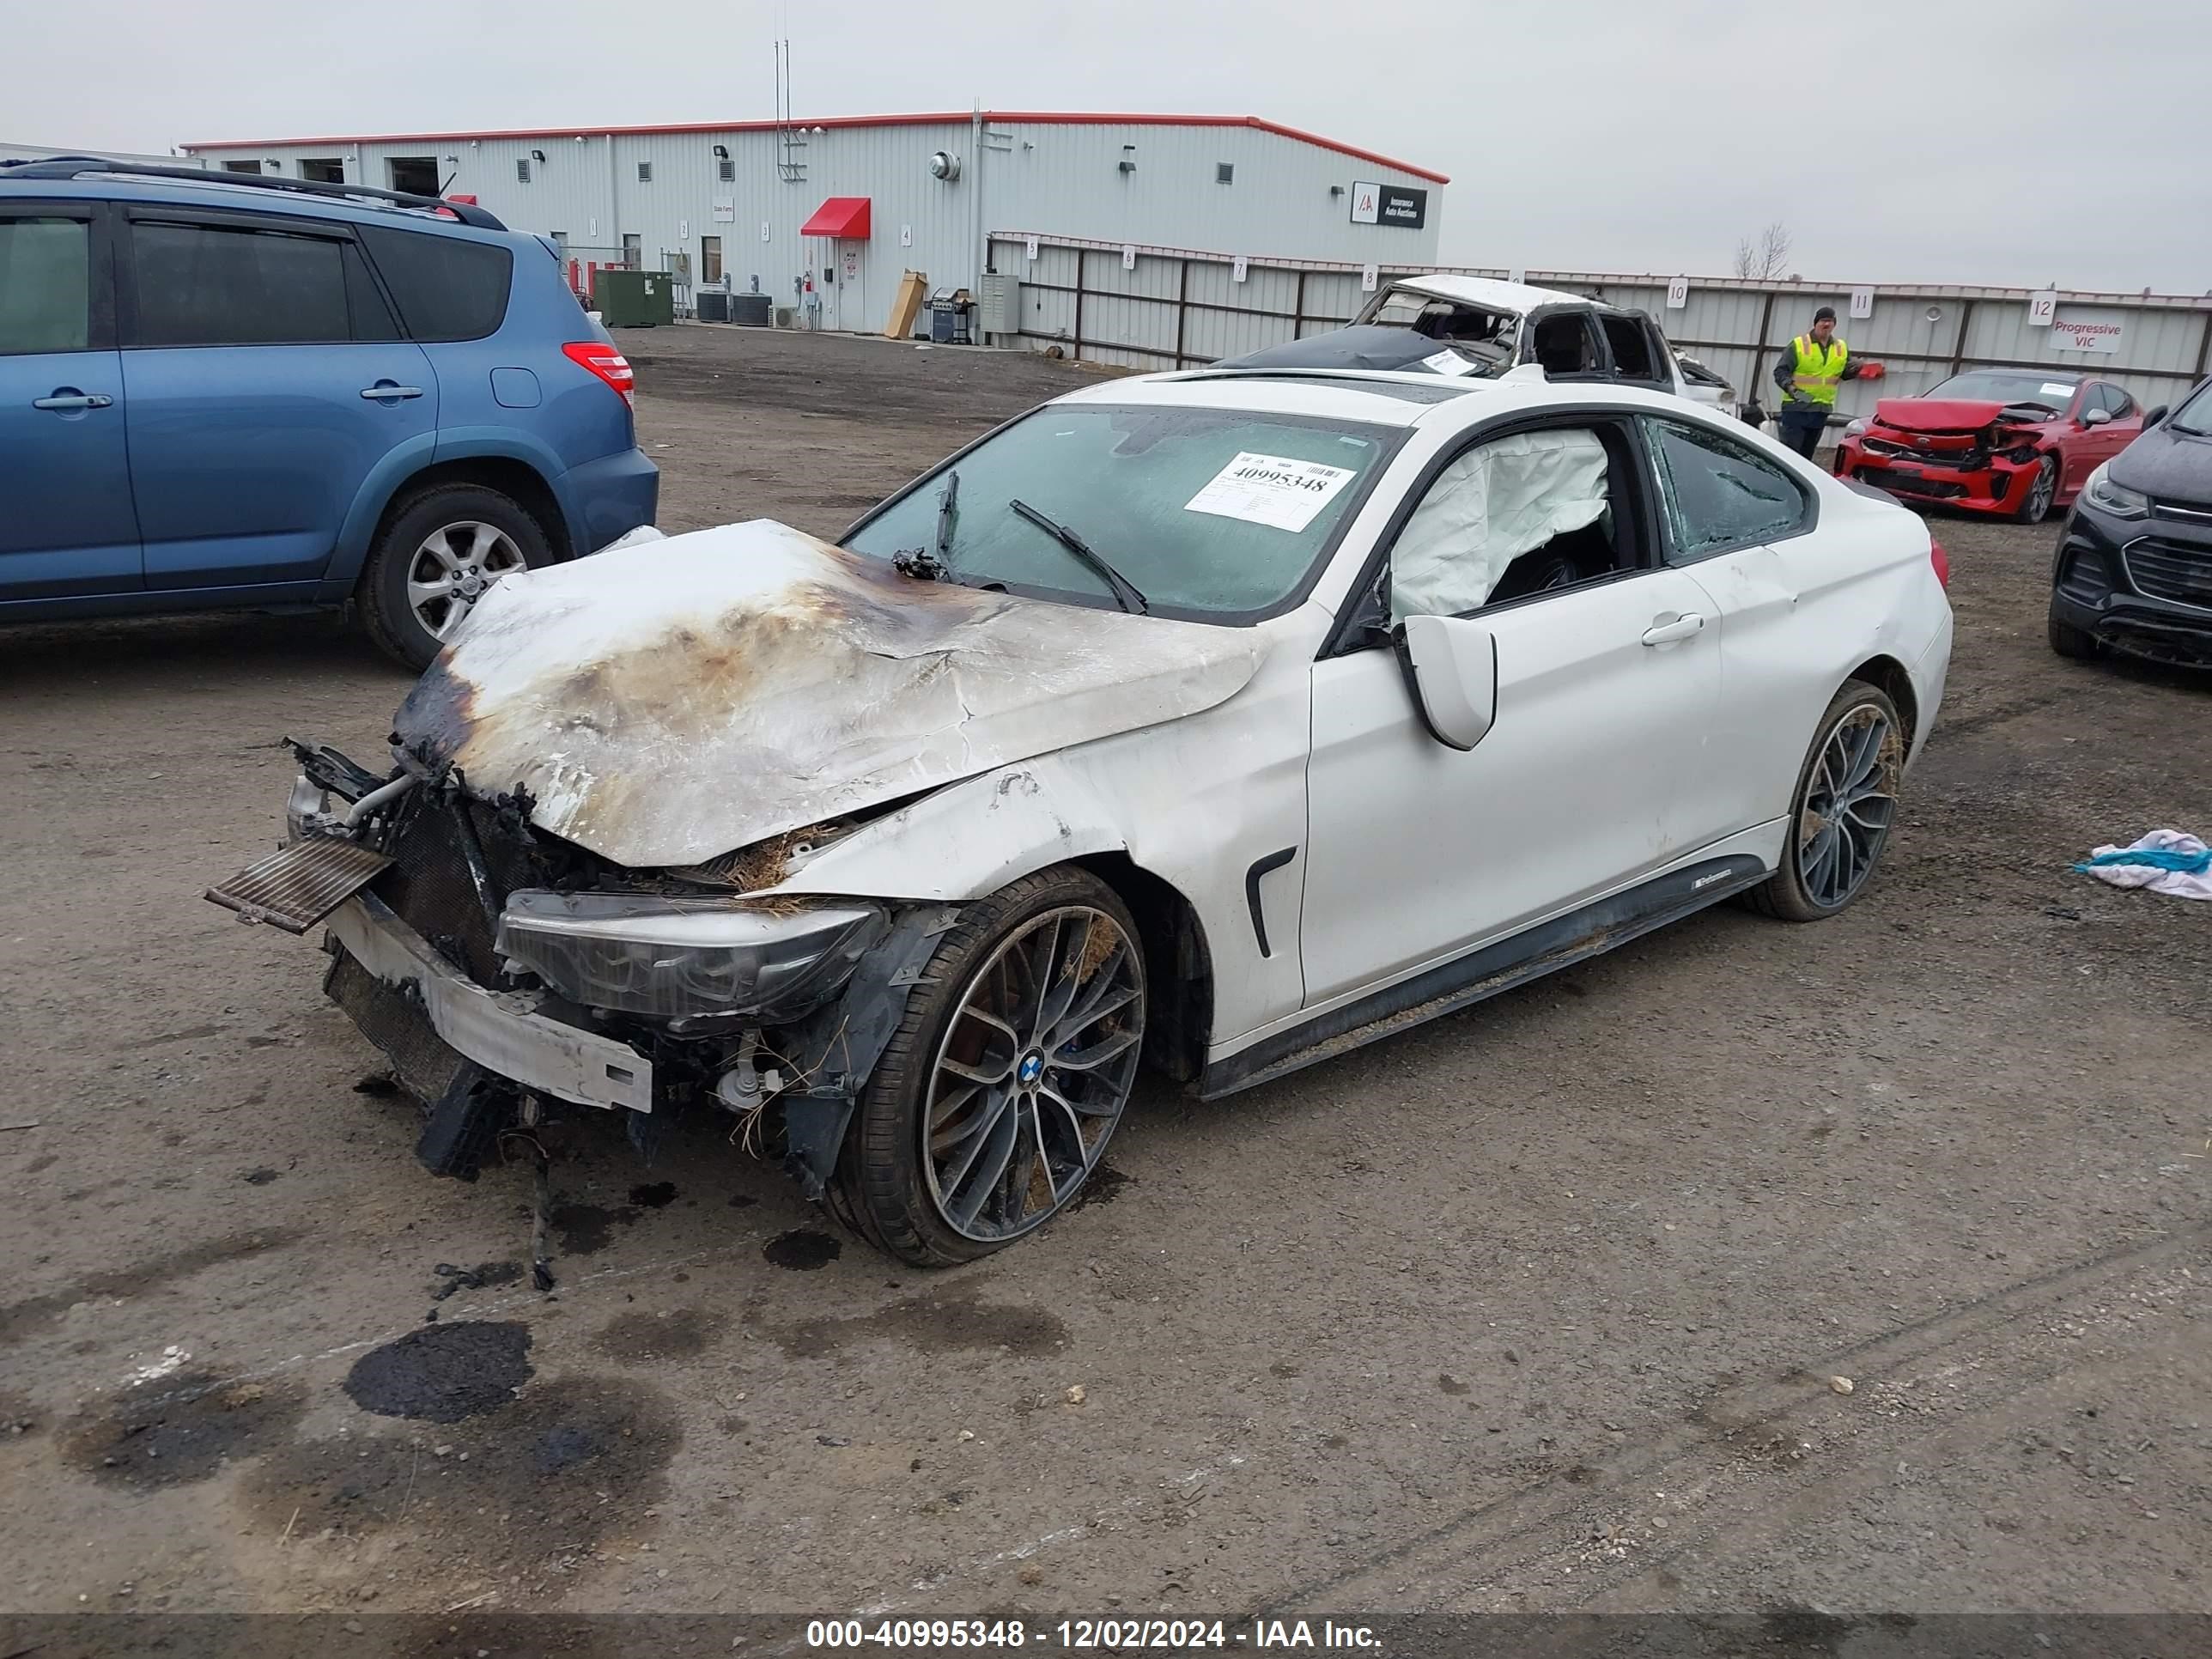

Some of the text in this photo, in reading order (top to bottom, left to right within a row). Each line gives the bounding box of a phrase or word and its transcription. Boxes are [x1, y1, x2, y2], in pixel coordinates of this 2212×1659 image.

[682, 224, 686, 234] 2
[903, 230, 908, 240] 4
[1030, 242, 1035, 252] 5
[1126, 252, 1132, 263] 6
[1237, 264, 1243, 276] 7
[1366, 271, 1373, 283] 8
[1669, 286, 1684, 300] 10
[1856, 295, 1867, 309] 11
[2034, 301, 2051, 316] 12
[2054, 321, 2121, 335] Progressive
[2075, 337, 2095, 348] VIC
[1233, 466, 1328, 493] 40995348
